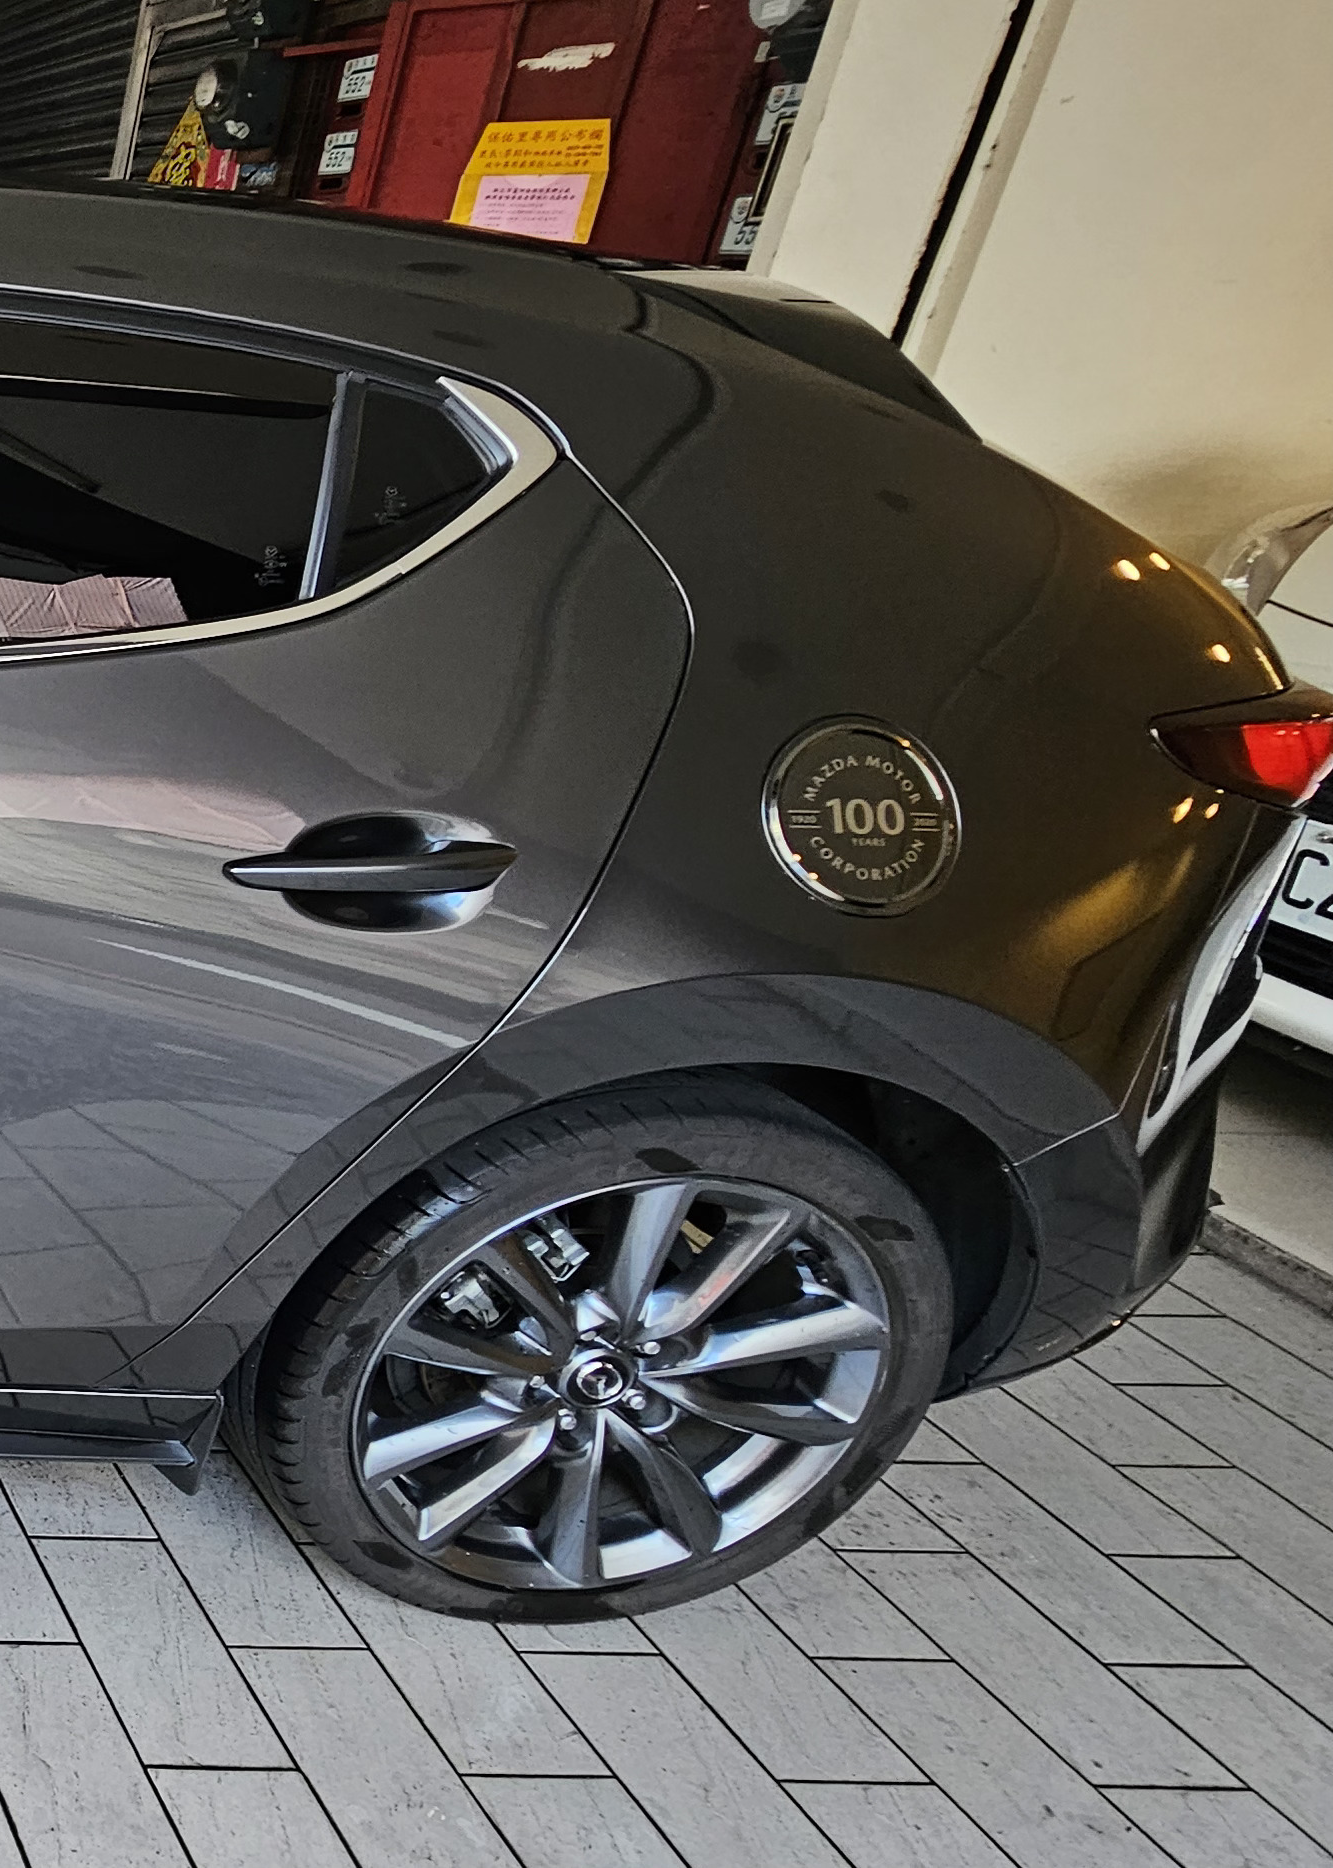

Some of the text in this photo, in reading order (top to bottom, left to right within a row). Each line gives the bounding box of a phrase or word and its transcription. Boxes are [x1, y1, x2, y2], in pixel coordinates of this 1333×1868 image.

[803, 755, 922, 804] MAZDA MOTOR
[825, 798, 906, 836] 100
[809, 836, 926, 882] CORPORATION
[851, 837, 887, 847] YEARS
